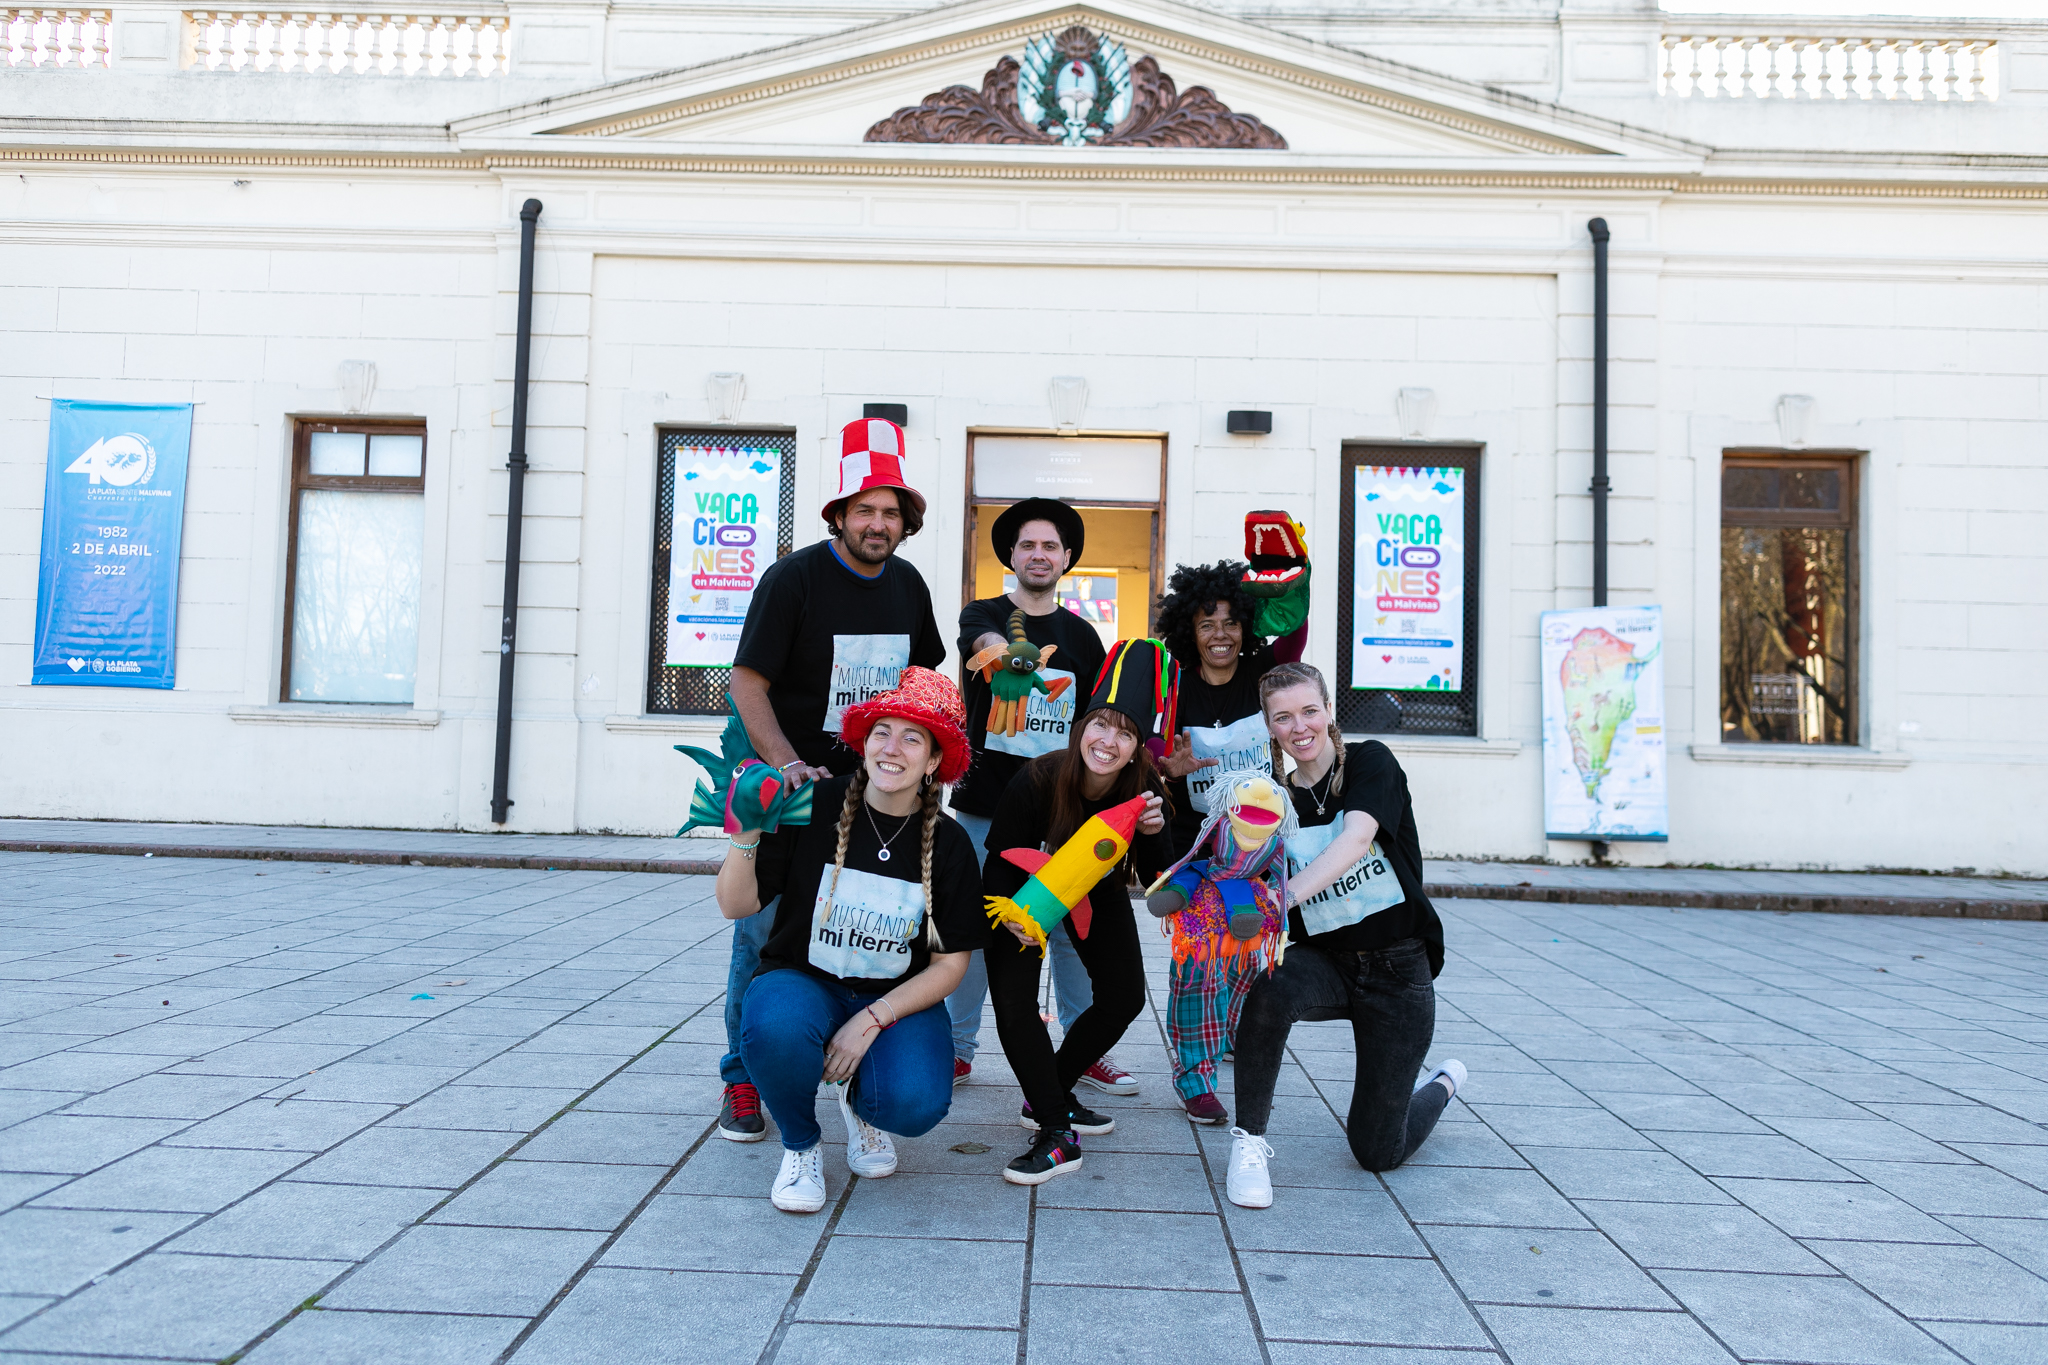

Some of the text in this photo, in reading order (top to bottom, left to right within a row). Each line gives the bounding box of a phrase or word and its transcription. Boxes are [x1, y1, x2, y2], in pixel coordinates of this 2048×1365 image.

[64, 436, 147, 487] 40
[694, 492, 759, 524] VACA
[98, 526, 128, 538] 1982
[1377, 513, 1443, 545] VACA
[72, 543, 152, 556] 2 DE ABRIL
[692, 548, 755, 574] NES
[94, 565, 126, 576] 2022
[694, 578, 752, 588] en Malvinas
[1376, 570, 1440, 595] NES
[1380, 600, 1439, 610] en Malvinas
[835, 688, 856, 706] mi
[1026, 695, 1069, 718] CANDO
[1025, 713, 1065, 735] ierra
[1332, 859, 1386, 897] tierra
[818, 927, 908, 955] mi tierra
